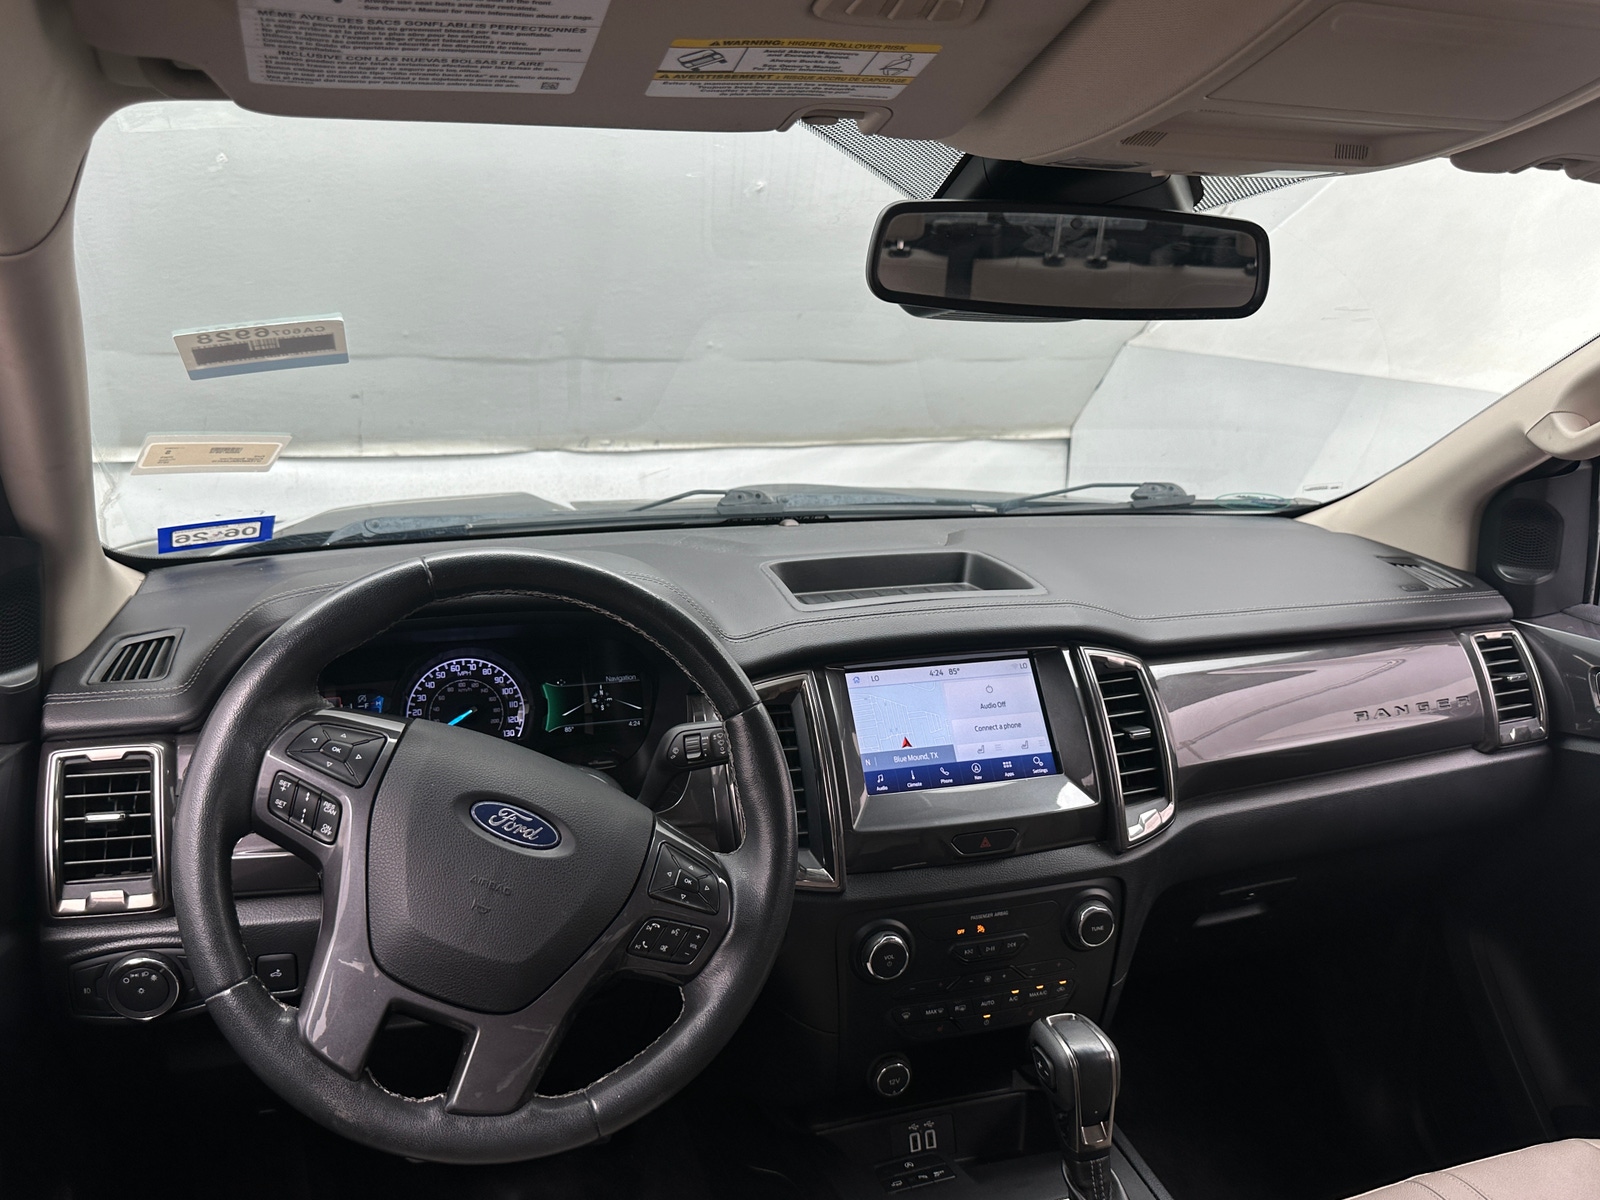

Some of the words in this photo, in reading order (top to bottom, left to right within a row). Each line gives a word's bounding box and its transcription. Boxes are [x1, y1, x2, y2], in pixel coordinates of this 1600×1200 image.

[300, 13, 334, 22] AVEC
[338, 17, 363, 25] DES
[367, 18, 401, 26] SACS
[404, 20, 487, 29] GONFLABLES
[828, 42, 883, 50] ROLLOVER
[278, 50, 342, 60] INCLUSIVE
[450, 664, 461, 672] 60
[1019, 662, 1028, 670] LO
[435, 671, 446, 679] 50
[482, 668, 492, 676] 80
[929, 669, 944, 677] 4:24
[948, 667, 960, 676] 85°
[494, 676, 504, 684] 90
[605, 674, 637, 683] Navigation
[425, 681, 435, 689] 40
[501, 687, 514, 695] 100
[416, 694, 427, 702] 30
[980, 702, 995, 710] Audio
[995, 701, 1006, 709] Off
[1353, 694, 1471, 722] RANGER
[974, 724, 998, 732] Connect
[1003, 721, 1022, 731] phone
[503, 729, 515, 737] 130
[331, 746, 342, 754] OK
[893, 755, 907, 763] Blue
[907, 752, 930, 763] Mound,
[930, 751, 939, 759] TX
[865, 758, 871, 766] N
[278, 779, 292, 788] SET
[274, 798, 287, 807] SET
[323, 801, 336, 809] RES
[323, 806, 337, 816] CAN
[322, 823, 332, 831] ON
[488, 807, 544, 841] Ford
[320, 827, 333, 836] OFF
[683, 877, 693, 885] OK
[980, 999, 995, 1007] AUTO
[888, 1077, 901, 1086] 12V
